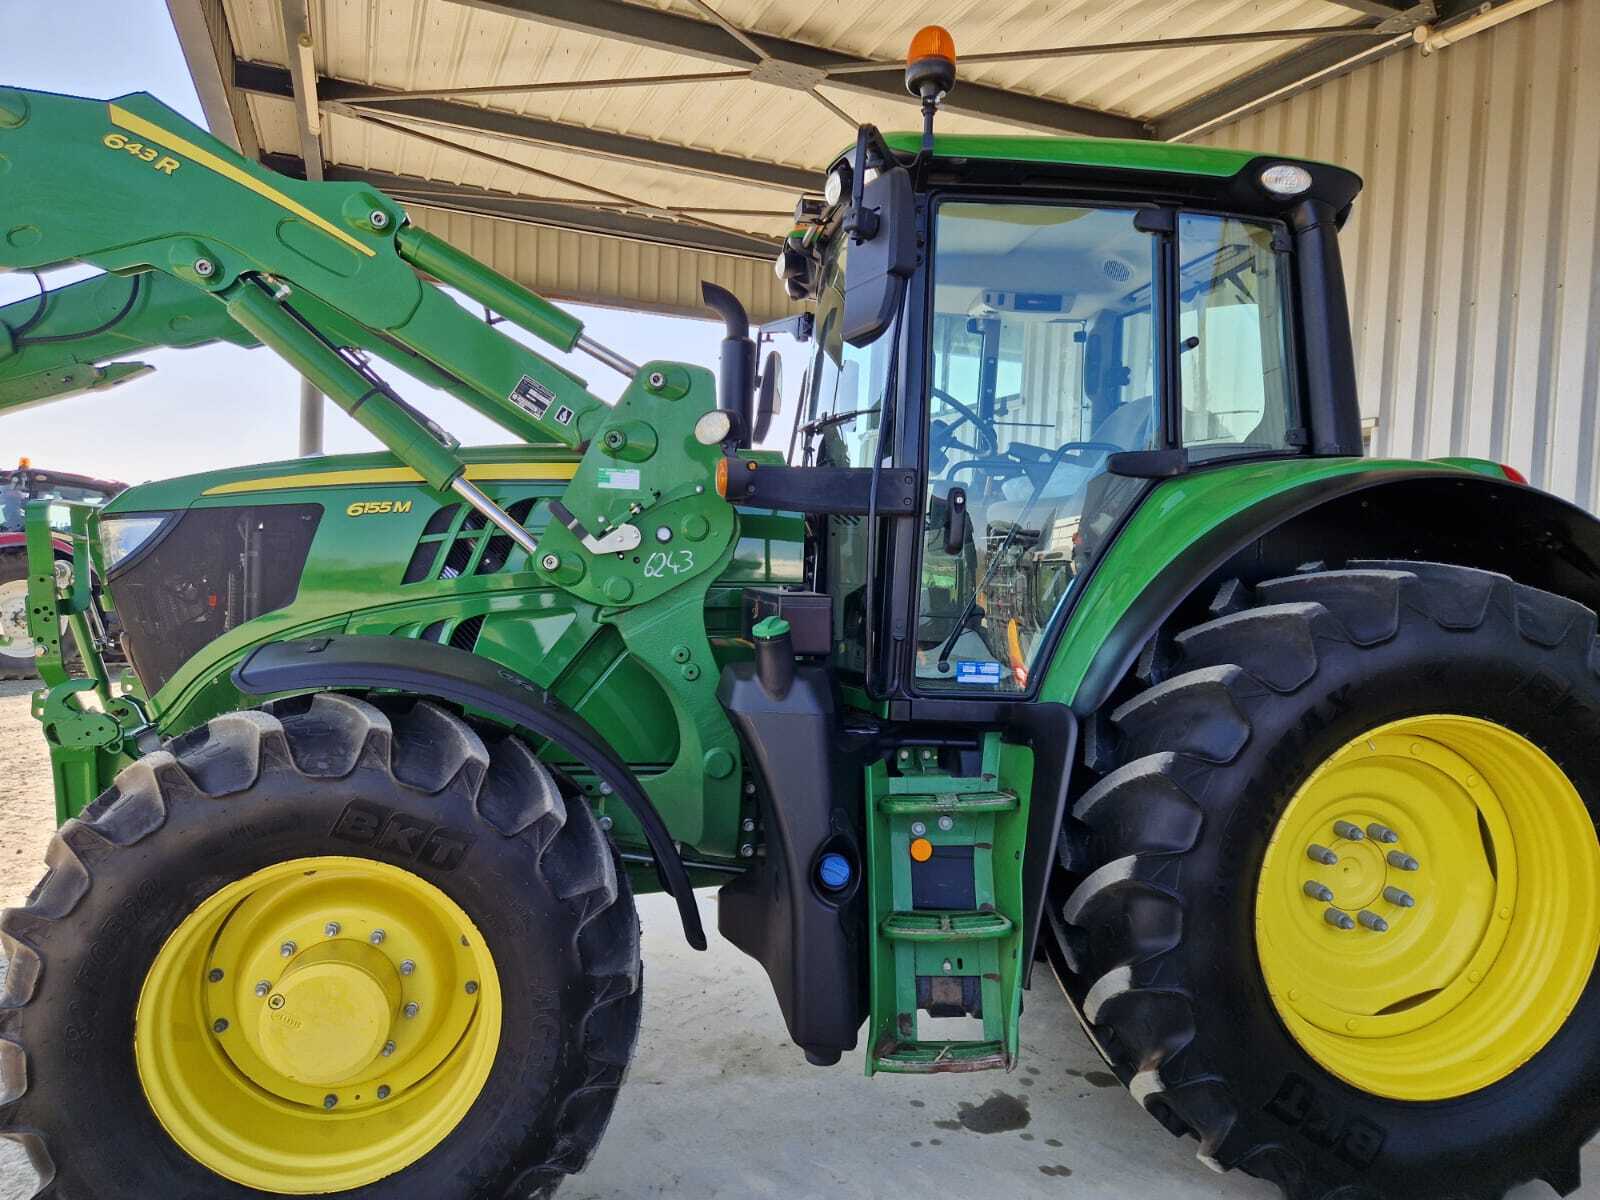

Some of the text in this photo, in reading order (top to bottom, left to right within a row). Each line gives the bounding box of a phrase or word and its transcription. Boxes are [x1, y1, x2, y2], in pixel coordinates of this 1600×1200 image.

[103, 133, 181, 175] 643 R
[346, 500, 413, 517] 6155 M
[643, 550, 694, 577] 6243
[332, 798, 478, 869] BKT
